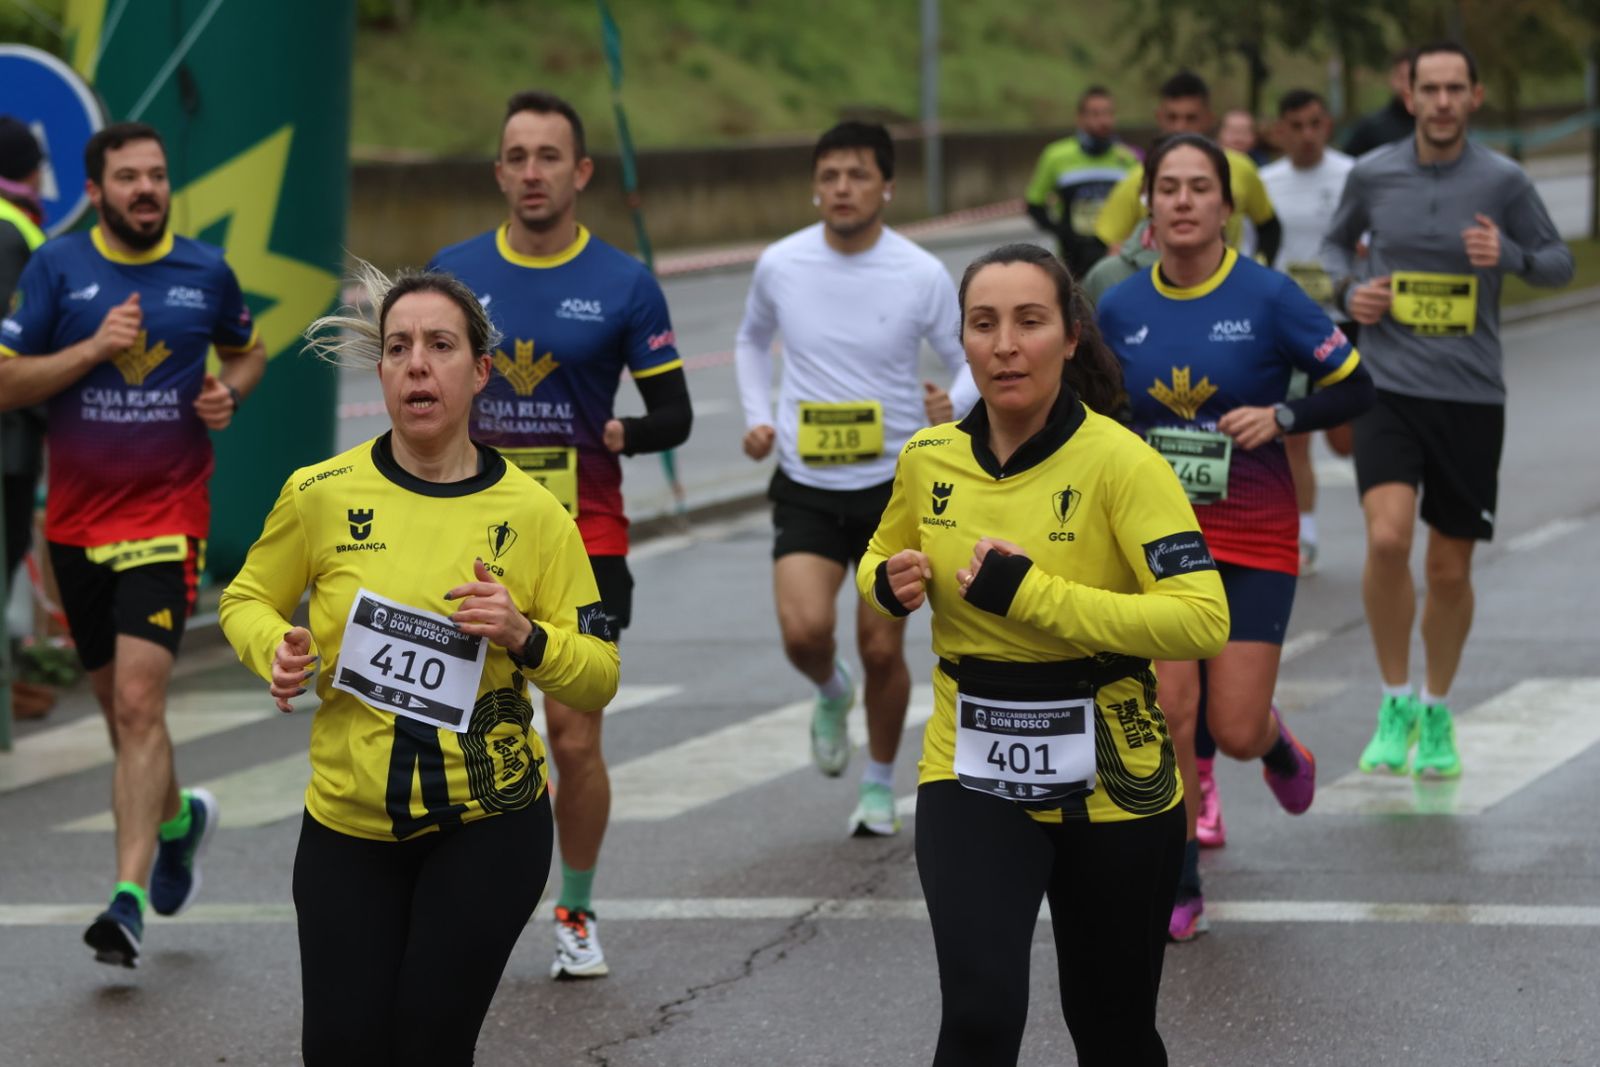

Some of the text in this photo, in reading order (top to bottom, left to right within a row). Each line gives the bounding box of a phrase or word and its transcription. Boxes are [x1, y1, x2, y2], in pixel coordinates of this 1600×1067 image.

[561, 298, 602, 314] ADAS
[1412, 300, 1453, 320] 262
[1213, 320, 1251, 334] ADAS
[479, 399, 574, 419] CAJA RURAL
[817, 429, 861, 450] 218
[918, 438, 953, 448] SPORT
[298, 465, 354, 492] CCI SPORT
[1170, 461, 1212, 486] 46
[1048, 532, 1076, 542] GCB
[336, 542, 387, 553] BRAGANÇA
[389, 619, 413, 634] DON
[414, 626, 450, 645] BOSCO
[391, 611, 470, 641] XXXI CARRERA POPULAR
[369, 643, 446, 691] 410
[990, 710, 1071, 719] XXXI CARRERA POPULAR
[990, 717, 1051, 729] DON BOSCO
[987, 740, 1057, 775] 401
